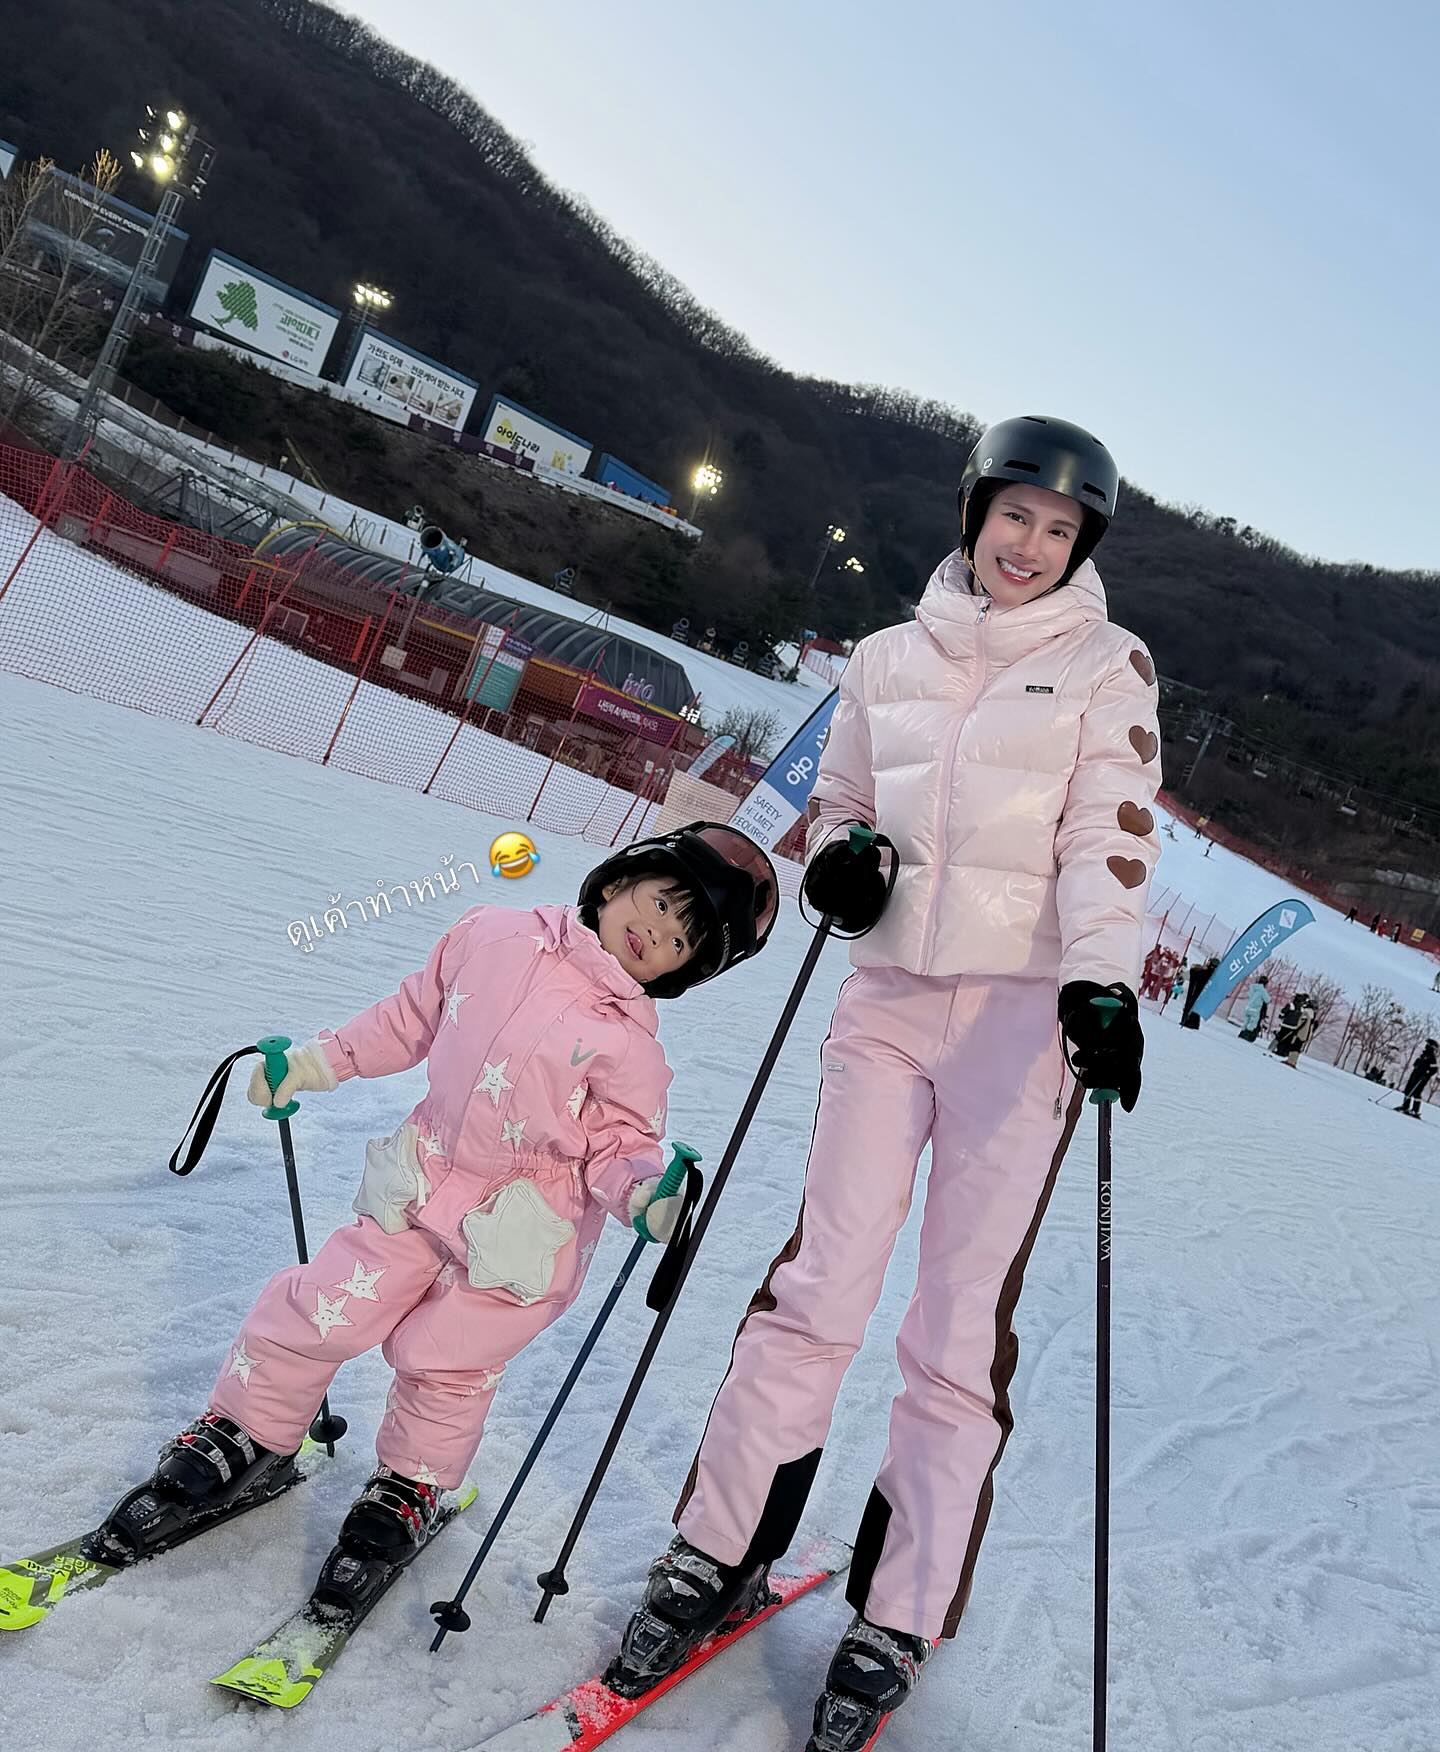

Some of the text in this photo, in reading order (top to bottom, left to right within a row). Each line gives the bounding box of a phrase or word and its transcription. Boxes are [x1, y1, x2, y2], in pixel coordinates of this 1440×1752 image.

[495, 423, 541, 453] 아이들나라
[753, 795, 782, 820] SAFETY
[1229, 924, 1279, 980] 천천히
[1098, 1180, 1111, 1260] KONJIAM
[55, 1554, 94, 1570] TIGER
